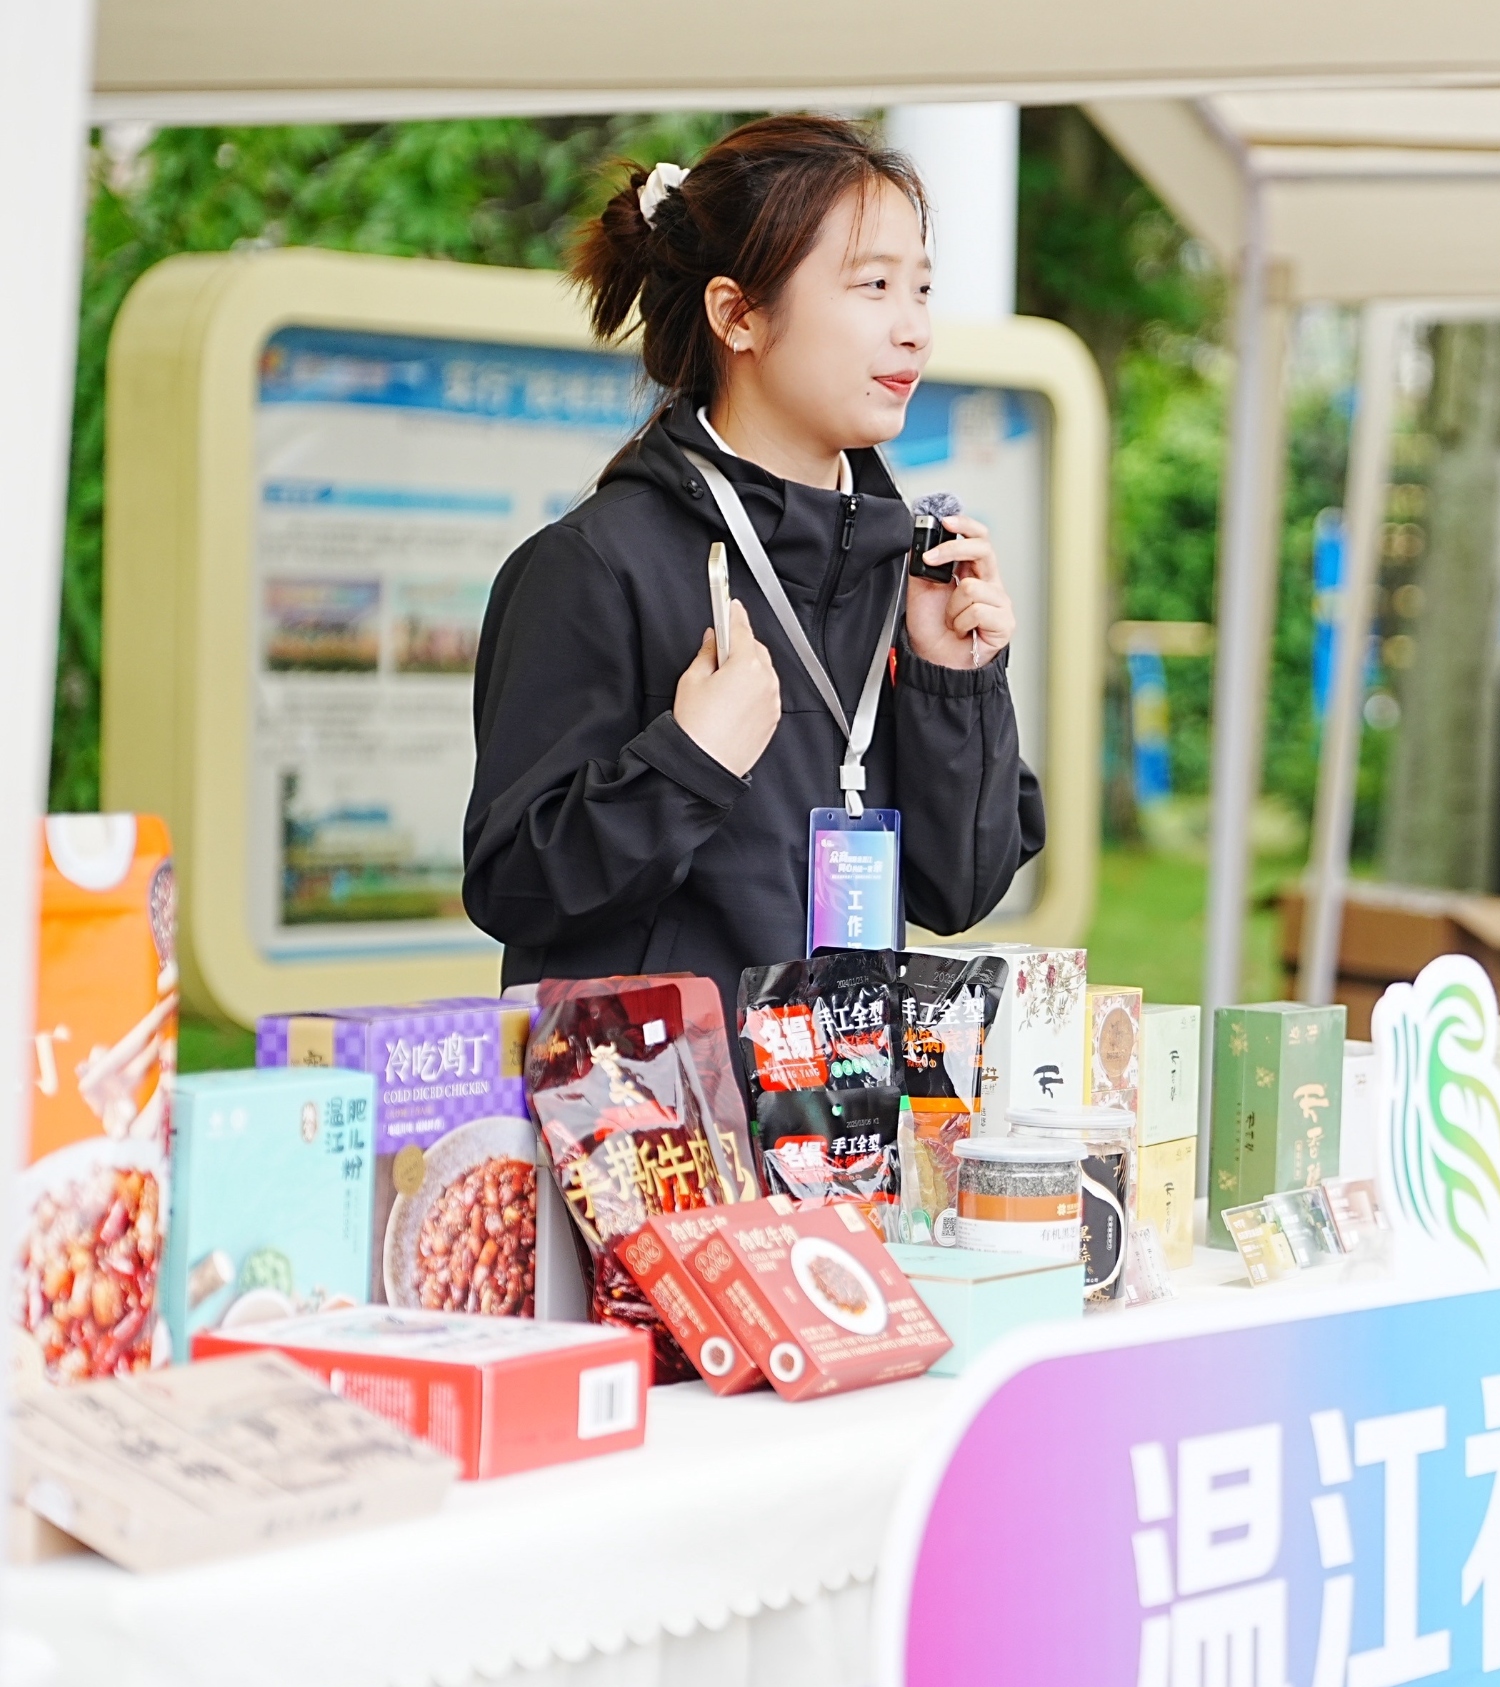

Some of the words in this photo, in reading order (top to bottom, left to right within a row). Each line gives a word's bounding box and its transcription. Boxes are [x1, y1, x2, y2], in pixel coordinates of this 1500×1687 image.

[847, 890, 864, 949] 工作
[818, 1000, 884, 1033] 手工全型
[902, 997, 985, 1025] 手工全型
[385, 1031, 491, 1084] 冷吃鸡丁
[383, 1088, 411, 1105] COLD
[412, 1086, 443, 1103] DICED
[444, 1080, 491, 1099] CHICKEN
[324, 1096, 345, 1155] 温江
[341, 1098, 367, 1181] 肥儿粉
[831, 1133, 882, 1156] 手工全型
[565, 1128, 728, 1219] 手撕牛肉
[733, 1223, 799, 1252] 冷吃牛肉
